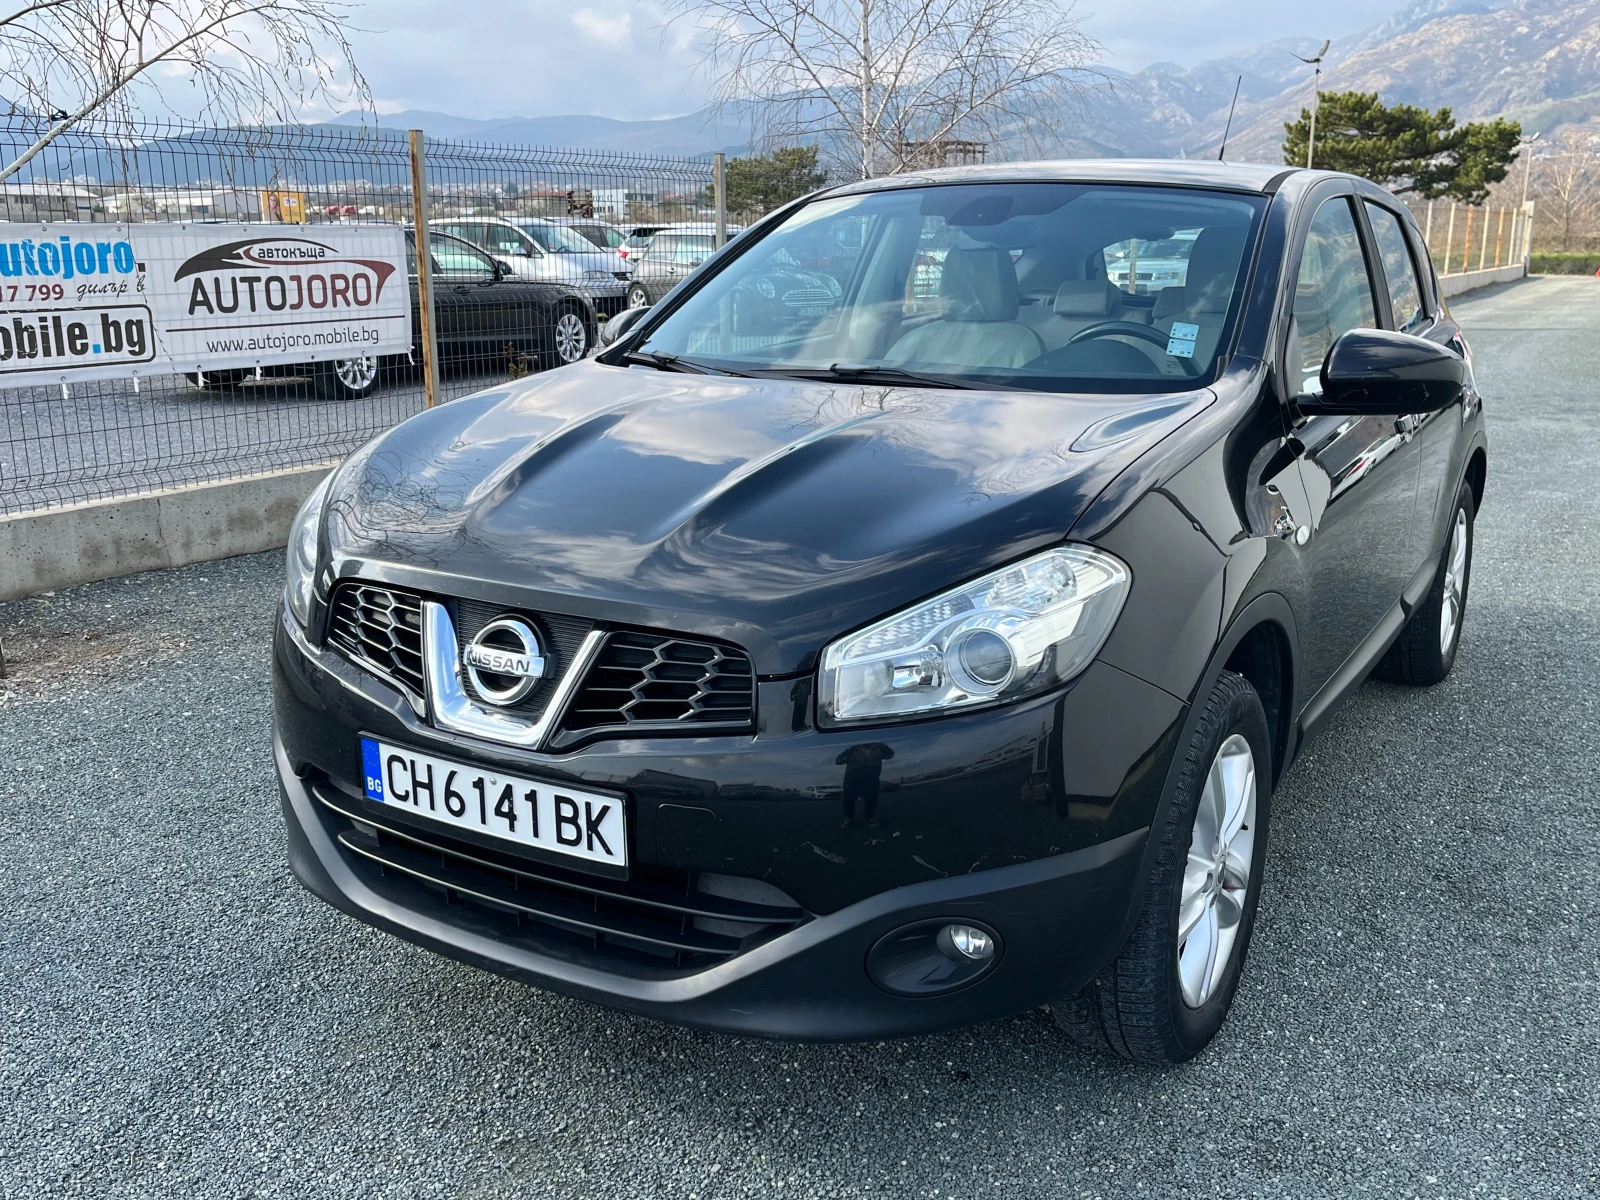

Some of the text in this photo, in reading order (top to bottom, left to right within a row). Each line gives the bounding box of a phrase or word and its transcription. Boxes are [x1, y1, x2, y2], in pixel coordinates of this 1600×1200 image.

[257, 247, 325, 259] автокъща
[25, 284, 64, 302] 799
[188, 273, 372, 315] AUTOJORO
[207, 326, 379, 353] www.autojoro.mobile.bg
[467, 647, 530, 673] NISSAN
[367, 776, 382, 793] BG
